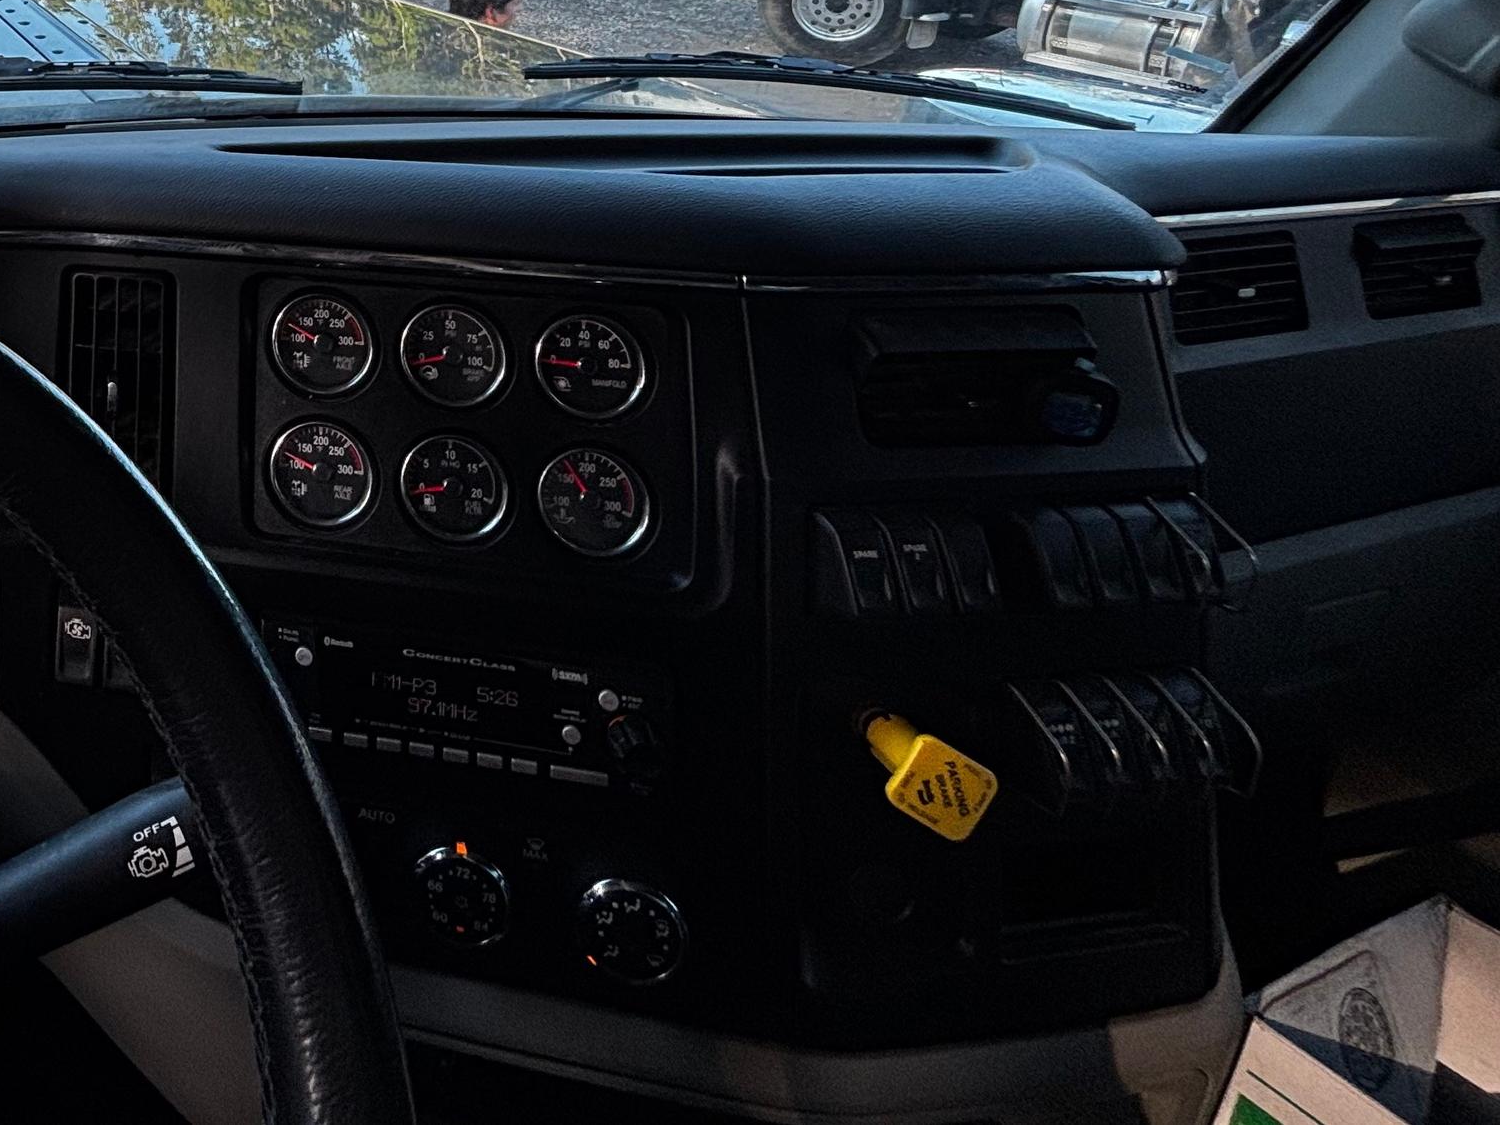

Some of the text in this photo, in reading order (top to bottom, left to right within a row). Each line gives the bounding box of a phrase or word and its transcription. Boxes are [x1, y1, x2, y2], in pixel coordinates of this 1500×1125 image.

[313, 309, 330, 318] 200
[299, 317, 313, 326] 150
[329, 318, 345, 328] 250
[444, 320, 456, 329] 50
[422, 331, 434, 341] 25
[466, 334, 478, 344] 75
[578, 330, 590, 340] 40
[338, 336, 354, 345] 300
[559, 338, 571, 347] 20
[598, 340, 610, 350] 60
[467, 357, 483, 366] 100
[608, 359, 620, 369] 80
[313, 436, 329, 446] 200
[298, 443, 312, 453] 150
[328, 446, 345, 456] 250
[444, 450, 456, 459] 10
[422, 458, 430, 468] 5
[579, 463, 596, 473] 200
[337, 465, 354, 474] 300
[467, 464, 478, 473] 15
[600, 477, 616, 487] 250
[470, 488, 483, 498] 20
[604, 501, 621, 511] 300
[476, 686, 519, 707] 5:26
[944, 760, 970, 816] PARKING
[358, 807, 396, 825] AUTO
[133, 822, 160, 842] OFF
[455, 866, 471, 878] 72
